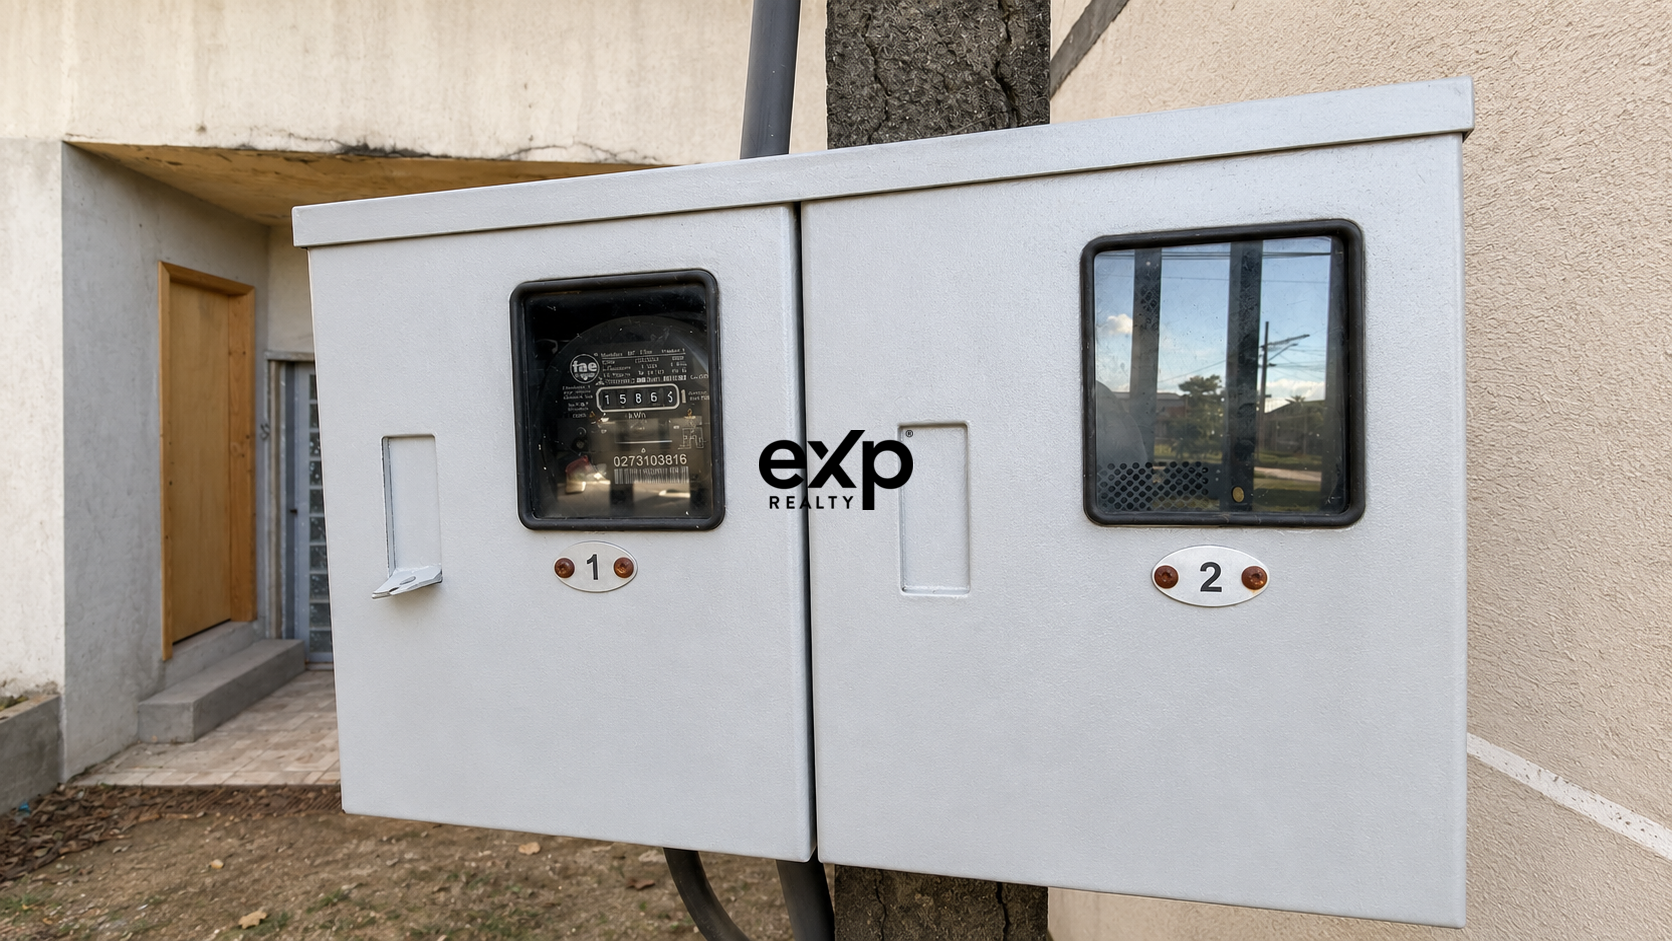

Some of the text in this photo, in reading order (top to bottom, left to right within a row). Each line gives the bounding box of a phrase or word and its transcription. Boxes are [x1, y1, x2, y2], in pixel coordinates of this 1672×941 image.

[572, 360, 597, 373] fae
[613, 453, 687, 467] 0273103816
[587, 554, 598, 580] 1
[1200, 562, 1222, 592] 2
